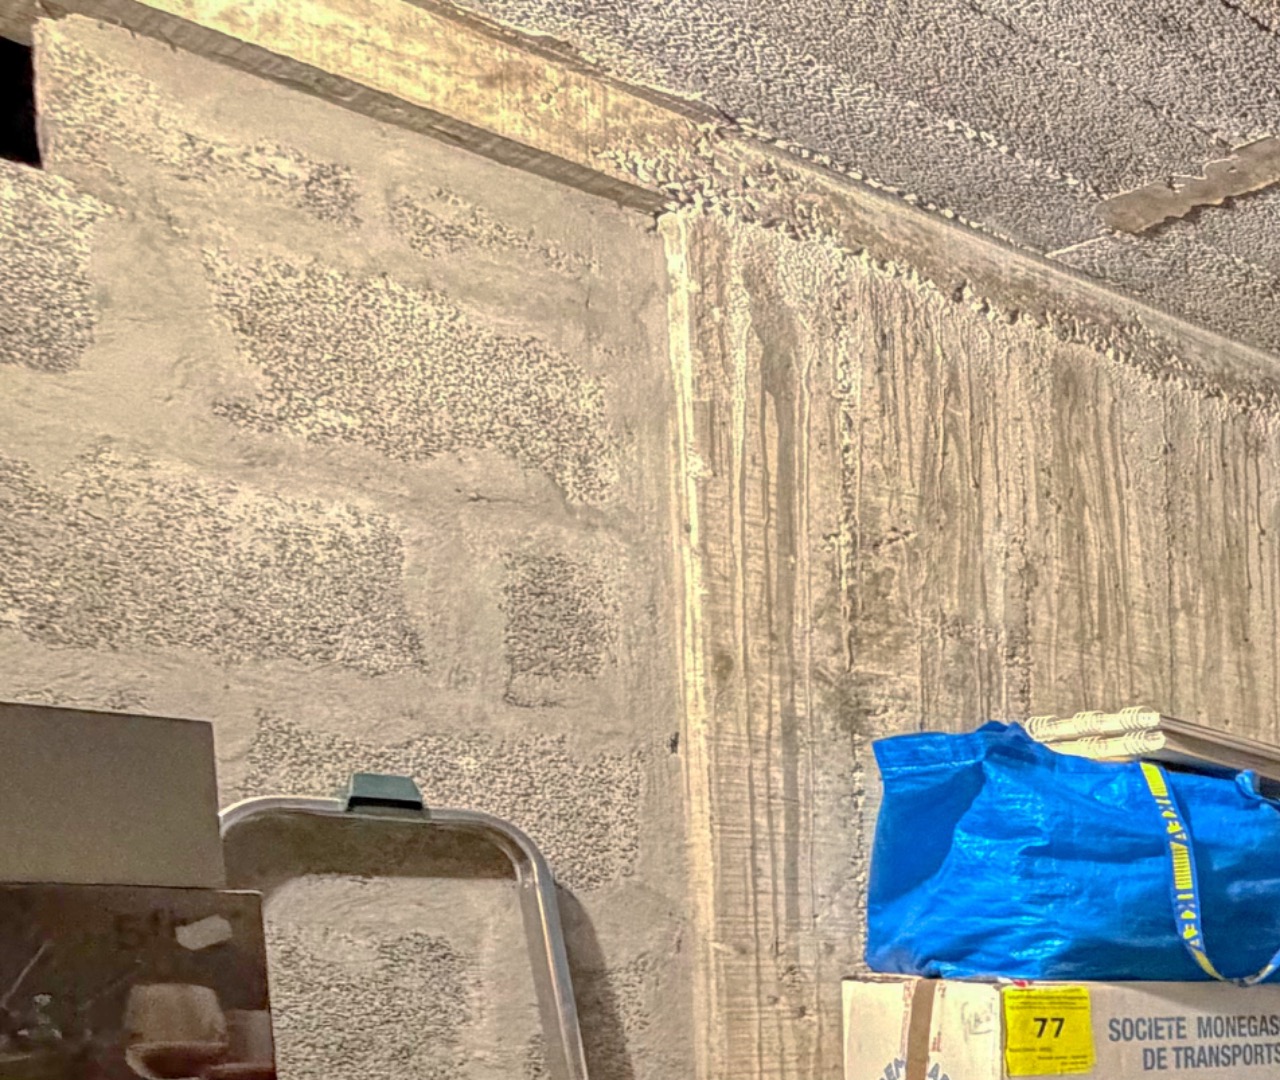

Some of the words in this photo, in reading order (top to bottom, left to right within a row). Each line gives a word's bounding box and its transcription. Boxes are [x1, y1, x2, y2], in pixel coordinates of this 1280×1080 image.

[1033, 1017, 1065, 1039] 77
[1108, 1016, 1187, 1042] SOCIETE
[1142, 1047, 1168, 1071] DE
